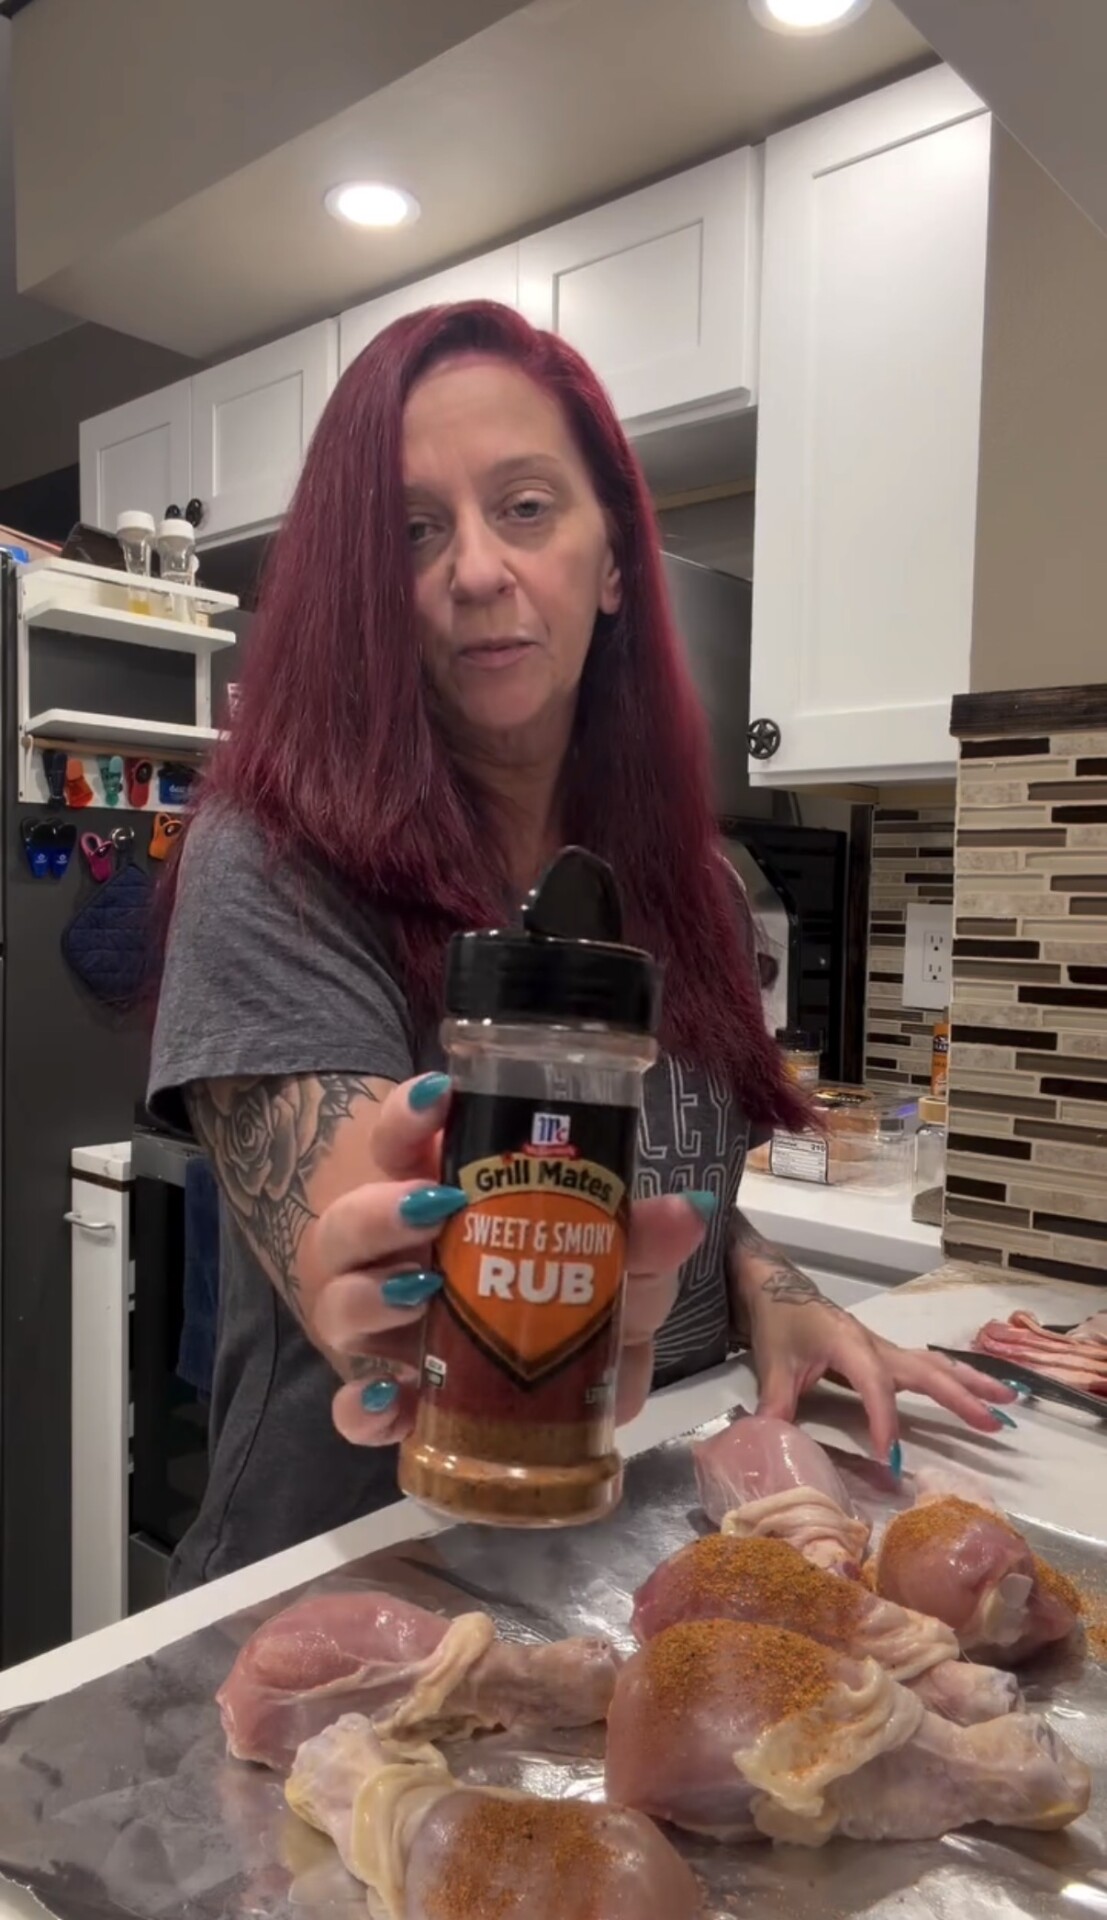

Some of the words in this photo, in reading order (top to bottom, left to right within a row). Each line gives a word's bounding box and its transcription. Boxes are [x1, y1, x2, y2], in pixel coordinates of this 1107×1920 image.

[476, 1159, 530, 1192] Grill
[538, 1160, 613, 1204] Mates
[463, 1213, 530, 1251] SWEET
[533, 1219, 548, 1253] &
[551, 1221, 616, 1255] SMOKY
[477, 1254, 594, 1305] RUB
